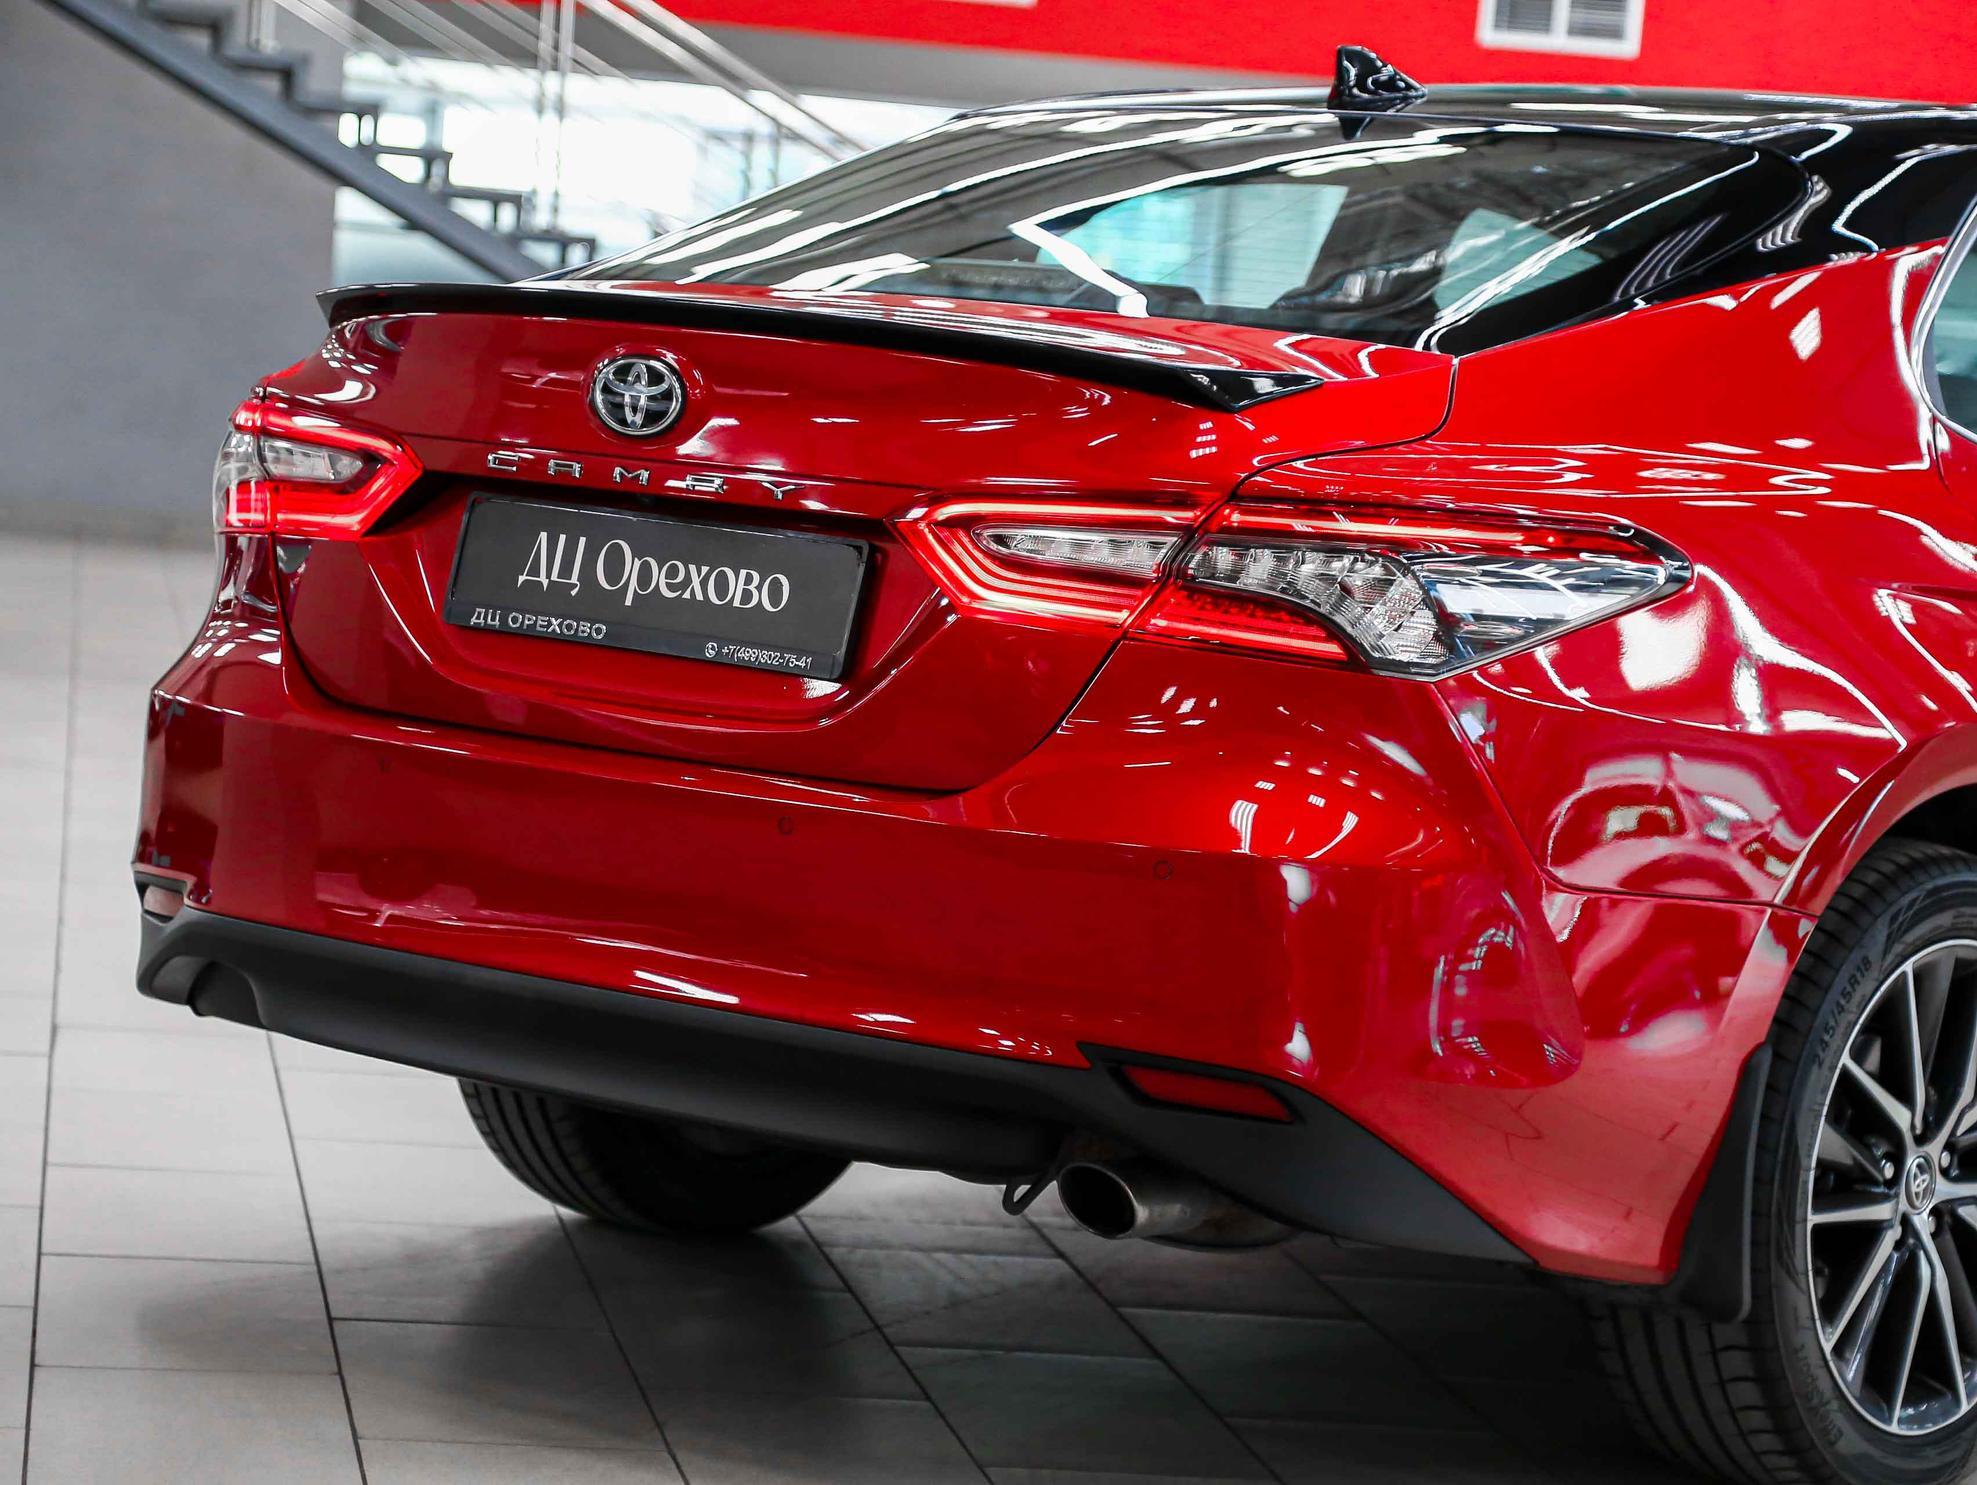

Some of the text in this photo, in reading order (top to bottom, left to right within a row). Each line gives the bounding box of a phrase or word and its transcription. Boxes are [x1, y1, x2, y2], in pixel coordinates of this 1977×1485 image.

[486, 451, 805, 501] CAMRY
[517, 531, 790, 612] ДЦ Орехово
[469, 607, 607, 640] ДЦ ОРЕХОВО
[721, 645, 812, 670] +7(499)302-75-41
[1814, 956, 1873, 1069] 245/45R18
